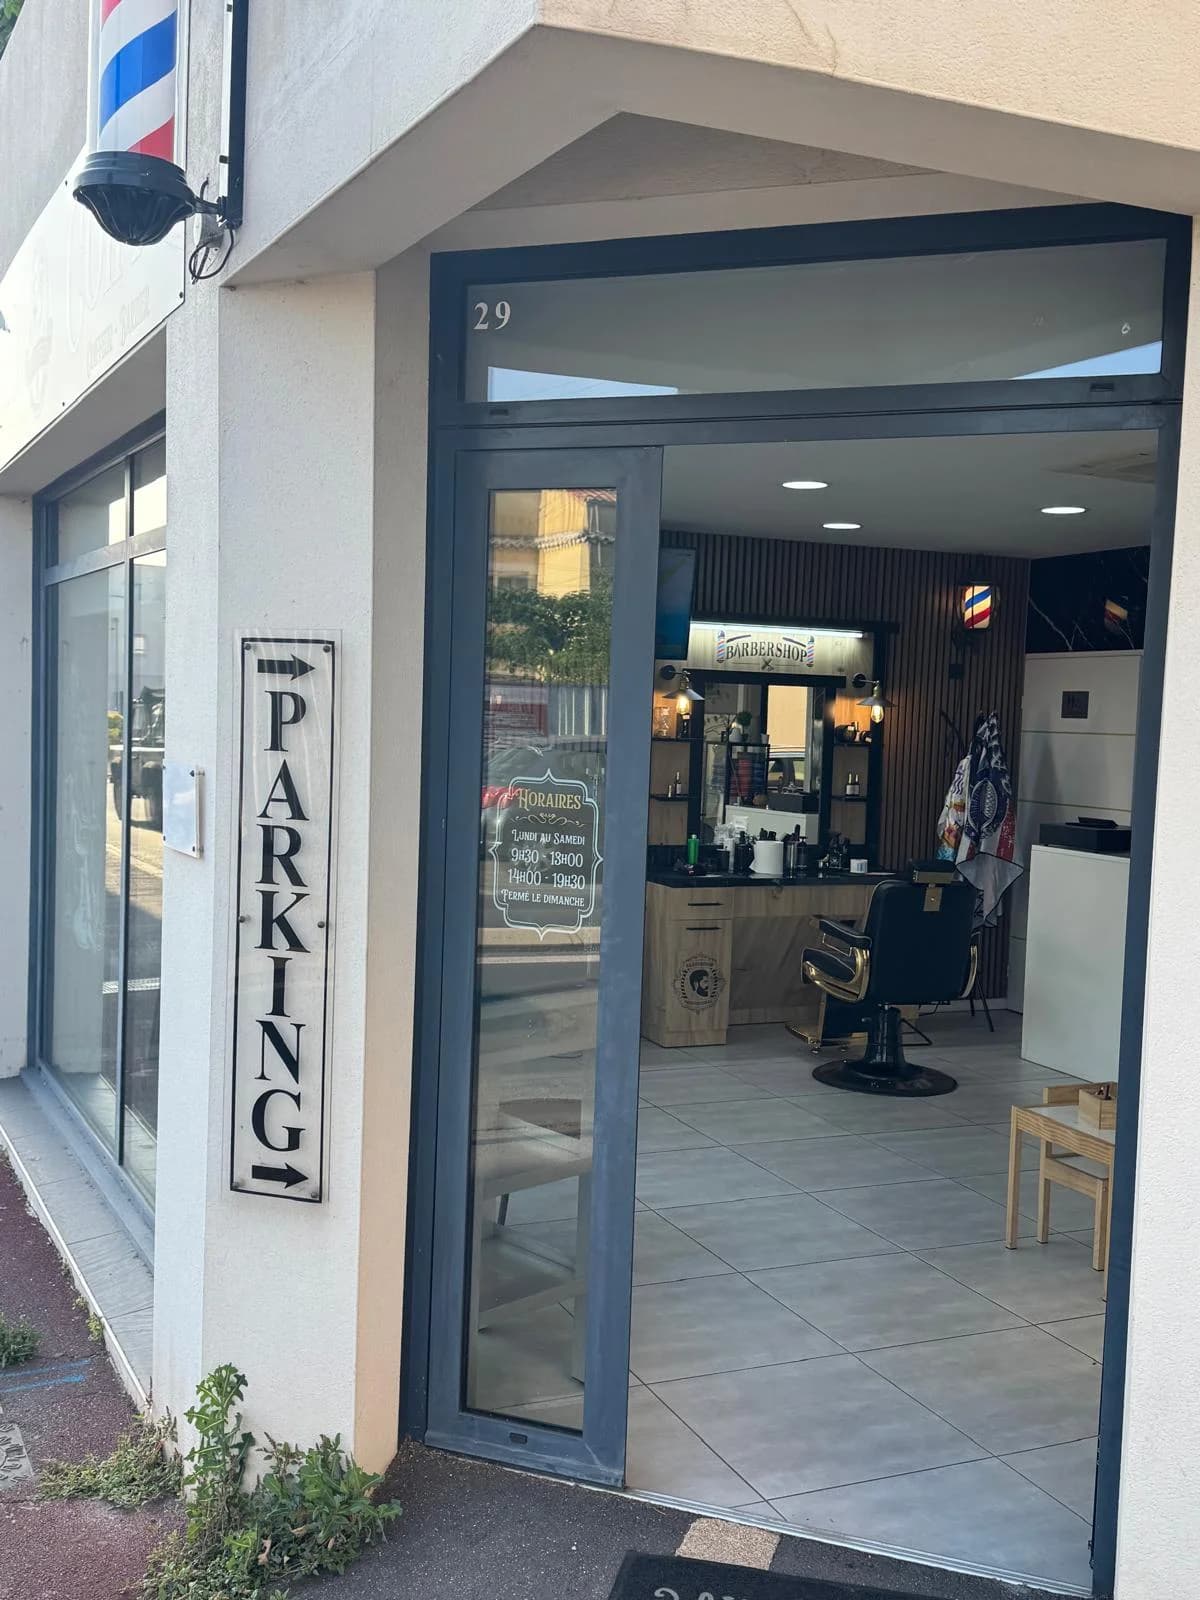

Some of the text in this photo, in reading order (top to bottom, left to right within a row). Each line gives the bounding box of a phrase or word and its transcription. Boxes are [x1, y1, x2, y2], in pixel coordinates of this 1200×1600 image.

[473, 301, 511, 330] 29
[726, 641, 807, 662] BARBERSHOP
[511, 847, 539, 864] 9H30
[549, 851, 584, 868] 13H00
[508, 868, 542, 885] 14H00
[552, 873, 586, 890] 19H30
[252, 690, 311, 1151] PARKING
